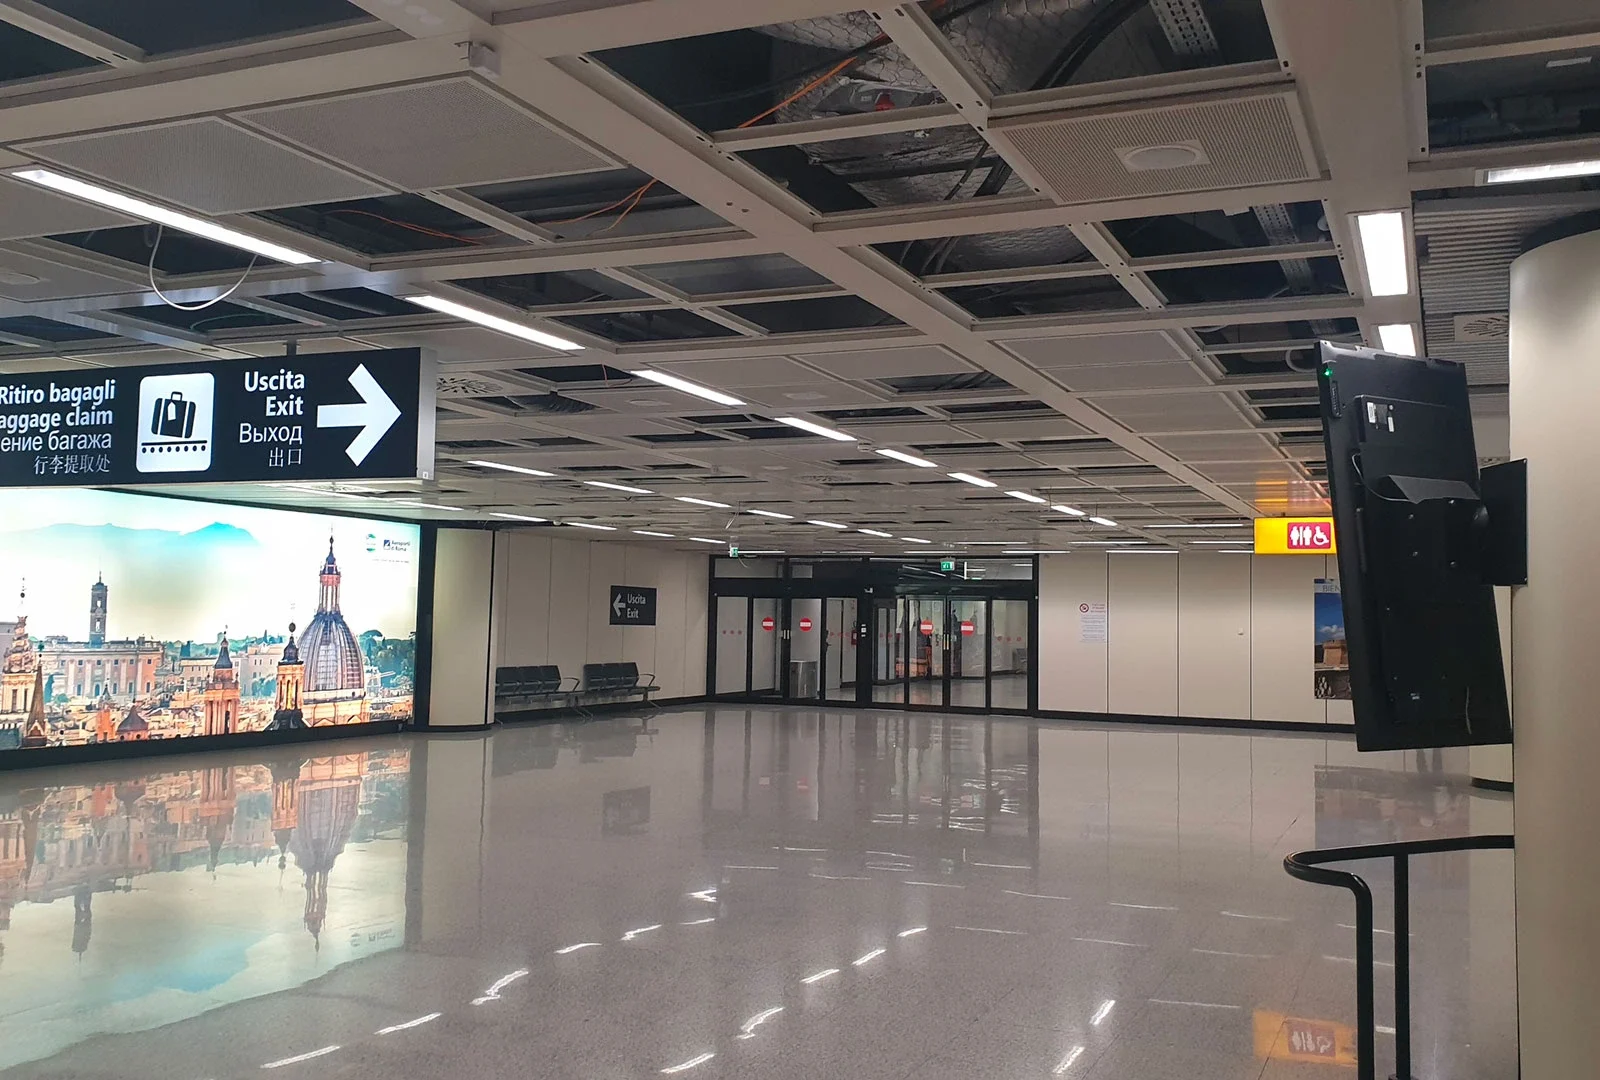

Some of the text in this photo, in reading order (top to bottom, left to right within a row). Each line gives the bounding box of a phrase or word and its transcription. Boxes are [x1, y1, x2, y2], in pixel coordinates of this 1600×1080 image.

[244, 368, 305, 392] Uscita
[0, 379, 116, 407] Ritiro bagagli
[65, 405, 113, 426] claim
[265, 394, 304, 416] Exit
[48, 430, 112, 451] багажа
[239, 422, 303, 445] Выход
[33, 453, 111, 475] 行李提取处
[269, 446, 302, 467] 出口
[627, 593, 646, 605] Uscita
[627, 608, 639, 619] Exit
